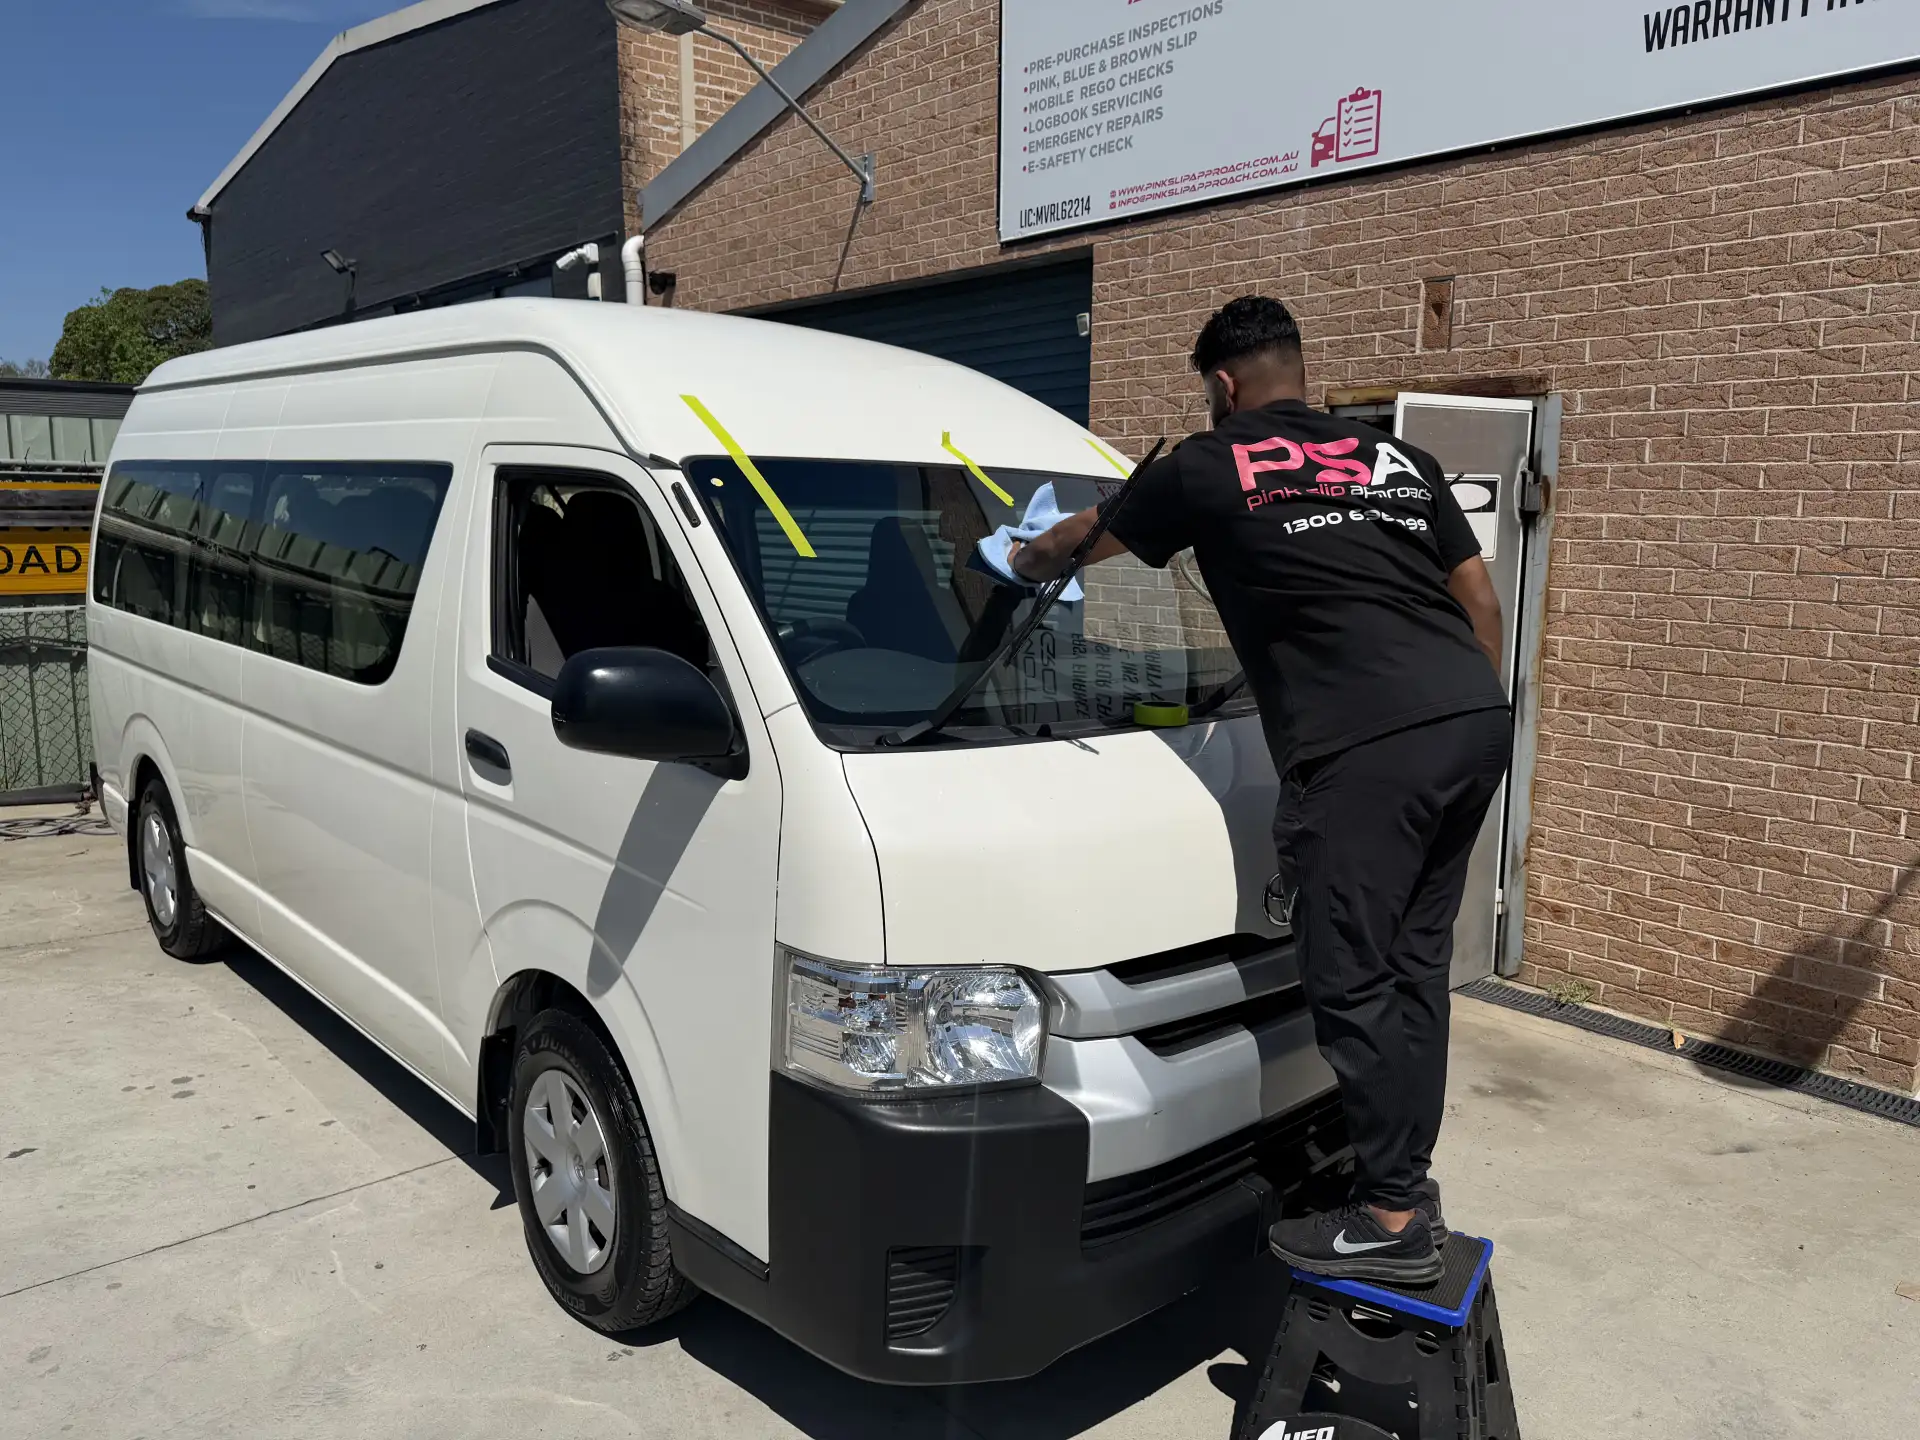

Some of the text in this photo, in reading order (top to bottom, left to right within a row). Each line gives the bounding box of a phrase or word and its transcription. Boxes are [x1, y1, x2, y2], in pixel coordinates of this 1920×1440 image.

[1029, 0, 1223, 75] PRE-PURCHASE INSPECTIONS
[1029, 31, 1198, 95] PINK, BLUE & BROWN SLIP
[1029, 60, 1174, 115] MOBILE REGO CHECKS
[1029, 85, 1163, 134] LOGBOOK SERVICING
[1028, 106, 1163, 154] EMERGENCY REPAIRS
[1028, 135, 1133, 173] E-SAFETY CHECK
[1117, 163, 1299, 209] INFO@PINKSLIPAPPROACH.COM.AU
[1118, 150, 1299, 197] WWW.PINKSLIPAPPROACH.COM.AU
[1231, 436, 1432, 492] PSA
[1246, 487, 1302, 511] pink
[1282, 512, 1343, 535] 1300
